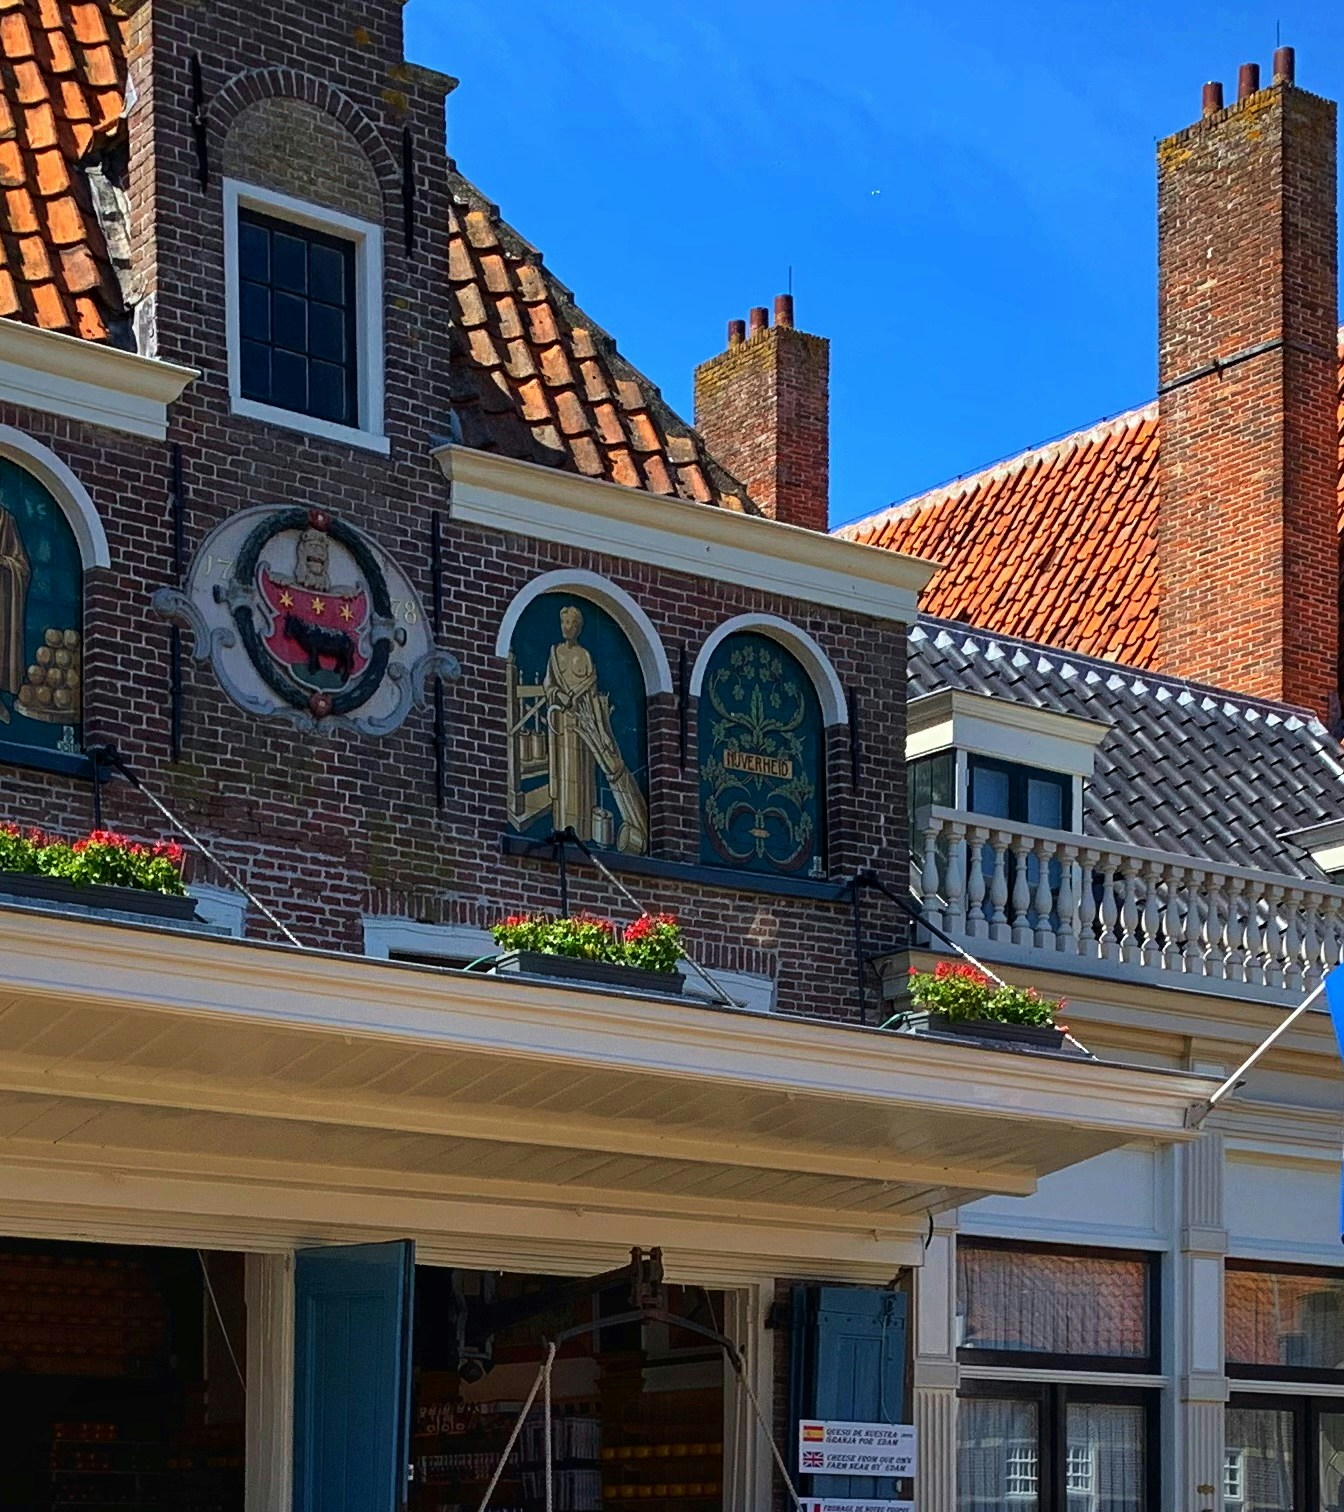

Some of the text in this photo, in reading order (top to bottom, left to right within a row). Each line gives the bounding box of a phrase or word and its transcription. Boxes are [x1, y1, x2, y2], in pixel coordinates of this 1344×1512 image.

[389, 598, 417, 625] 78
[877, 1438, 899, 1446] EDAM
[826, 1454, 856, 1462] CHEESE
[857, 1455, 878, 1463] FROM
[885, 1464, 907, 1472] EDAM
